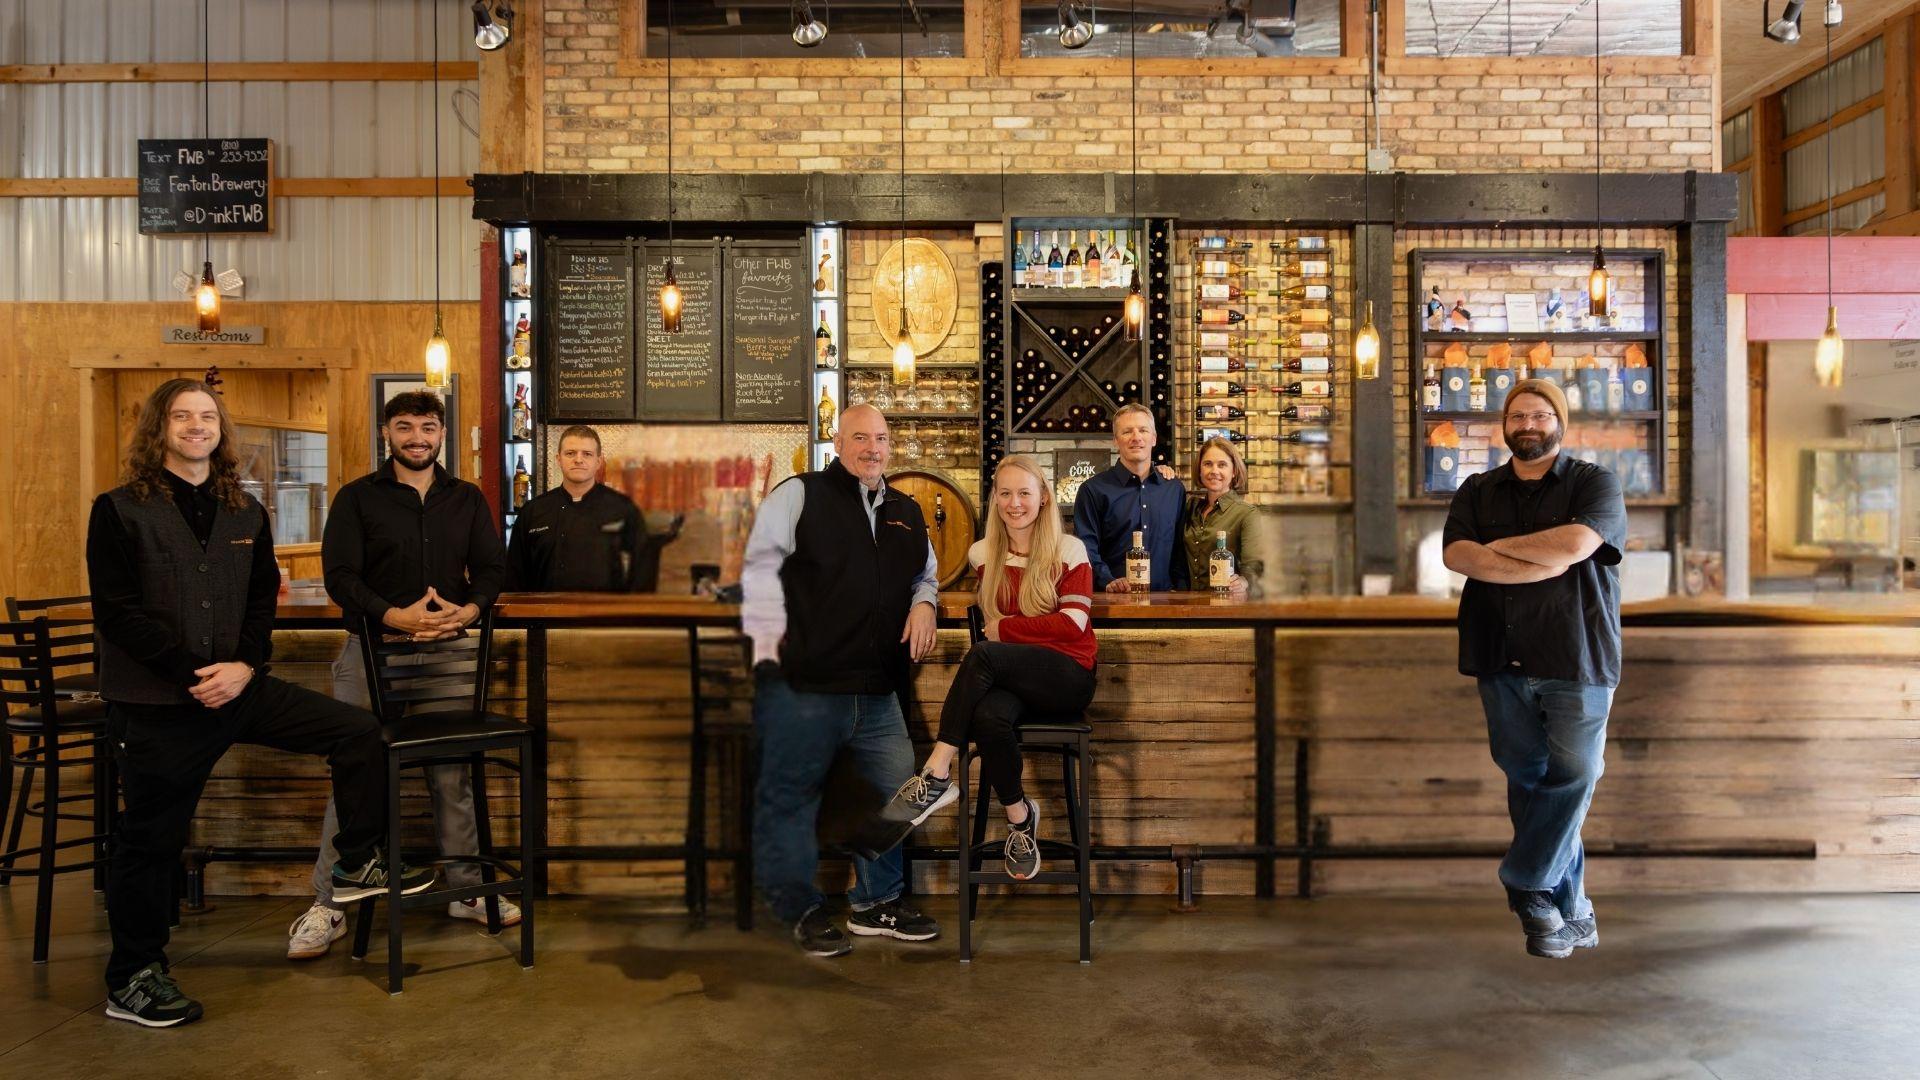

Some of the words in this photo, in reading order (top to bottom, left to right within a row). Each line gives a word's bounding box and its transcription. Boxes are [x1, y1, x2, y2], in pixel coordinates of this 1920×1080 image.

[142, 151, 172, 163] TEXT
[178, 148, 205, 165] FWB
[662, 256, 685, 264] WNE
[734, 258, 759, 274] Other
[766, 258, 792, 270] FWB
[172, 328, 253, 343] Restrooms
[736, 389, 753, 397] Root
[1069, 465, 1096, 480] CORK
